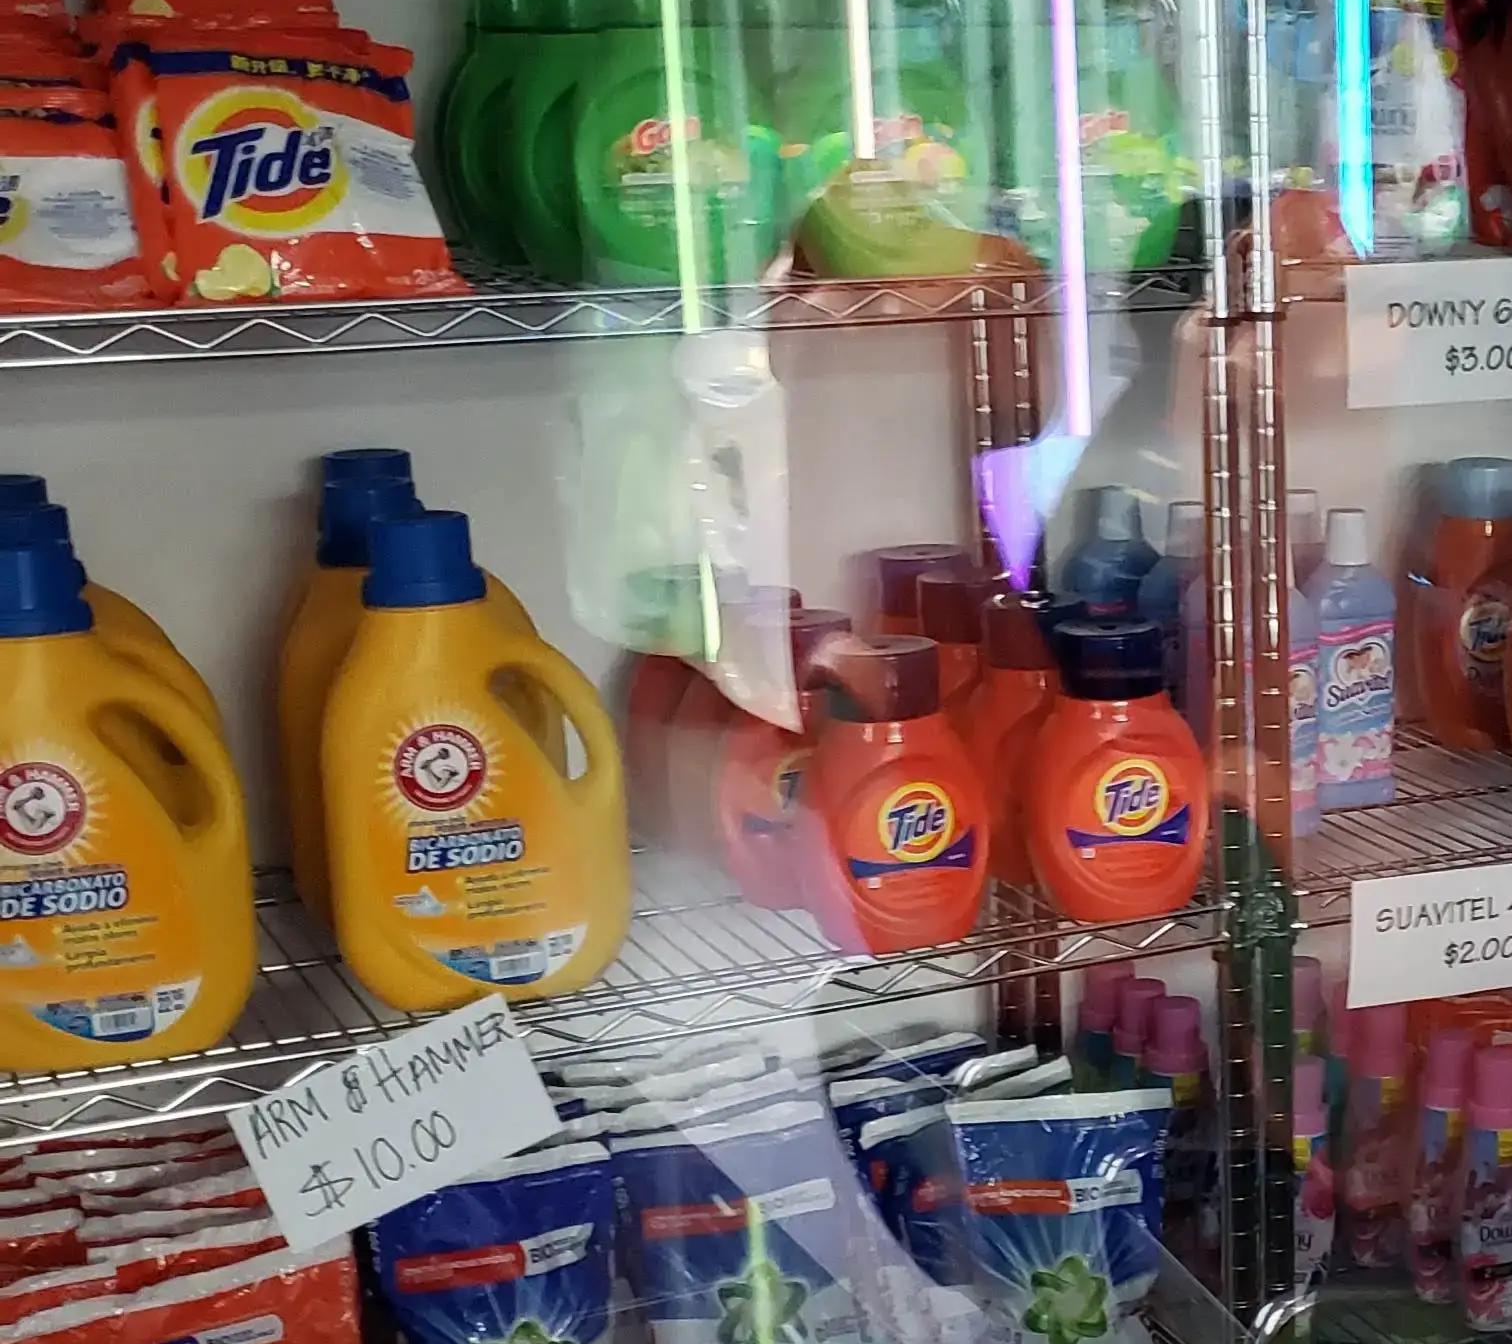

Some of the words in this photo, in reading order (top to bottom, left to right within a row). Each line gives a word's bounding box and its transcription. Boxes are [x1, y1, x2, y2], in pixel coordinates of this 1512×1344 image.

[191, 127, 332, 220] Tide
[1387, 301, 1486, 329] DOWNY
[1105, 776, 1161, 825] Tide
[887, 801, 946, 851] Tide
[408, 850, 444, 872] DE
[447, 840, 524, 868] SODIO
[0, 896, 38, 919] DE
[46, 886, 128, 916] SODIO
[1375, 896, 1500, 933] SUAVITEL
[249, 1086, 329, 1160] ARM
[363, 1010, 516, 1104] HAMMER
